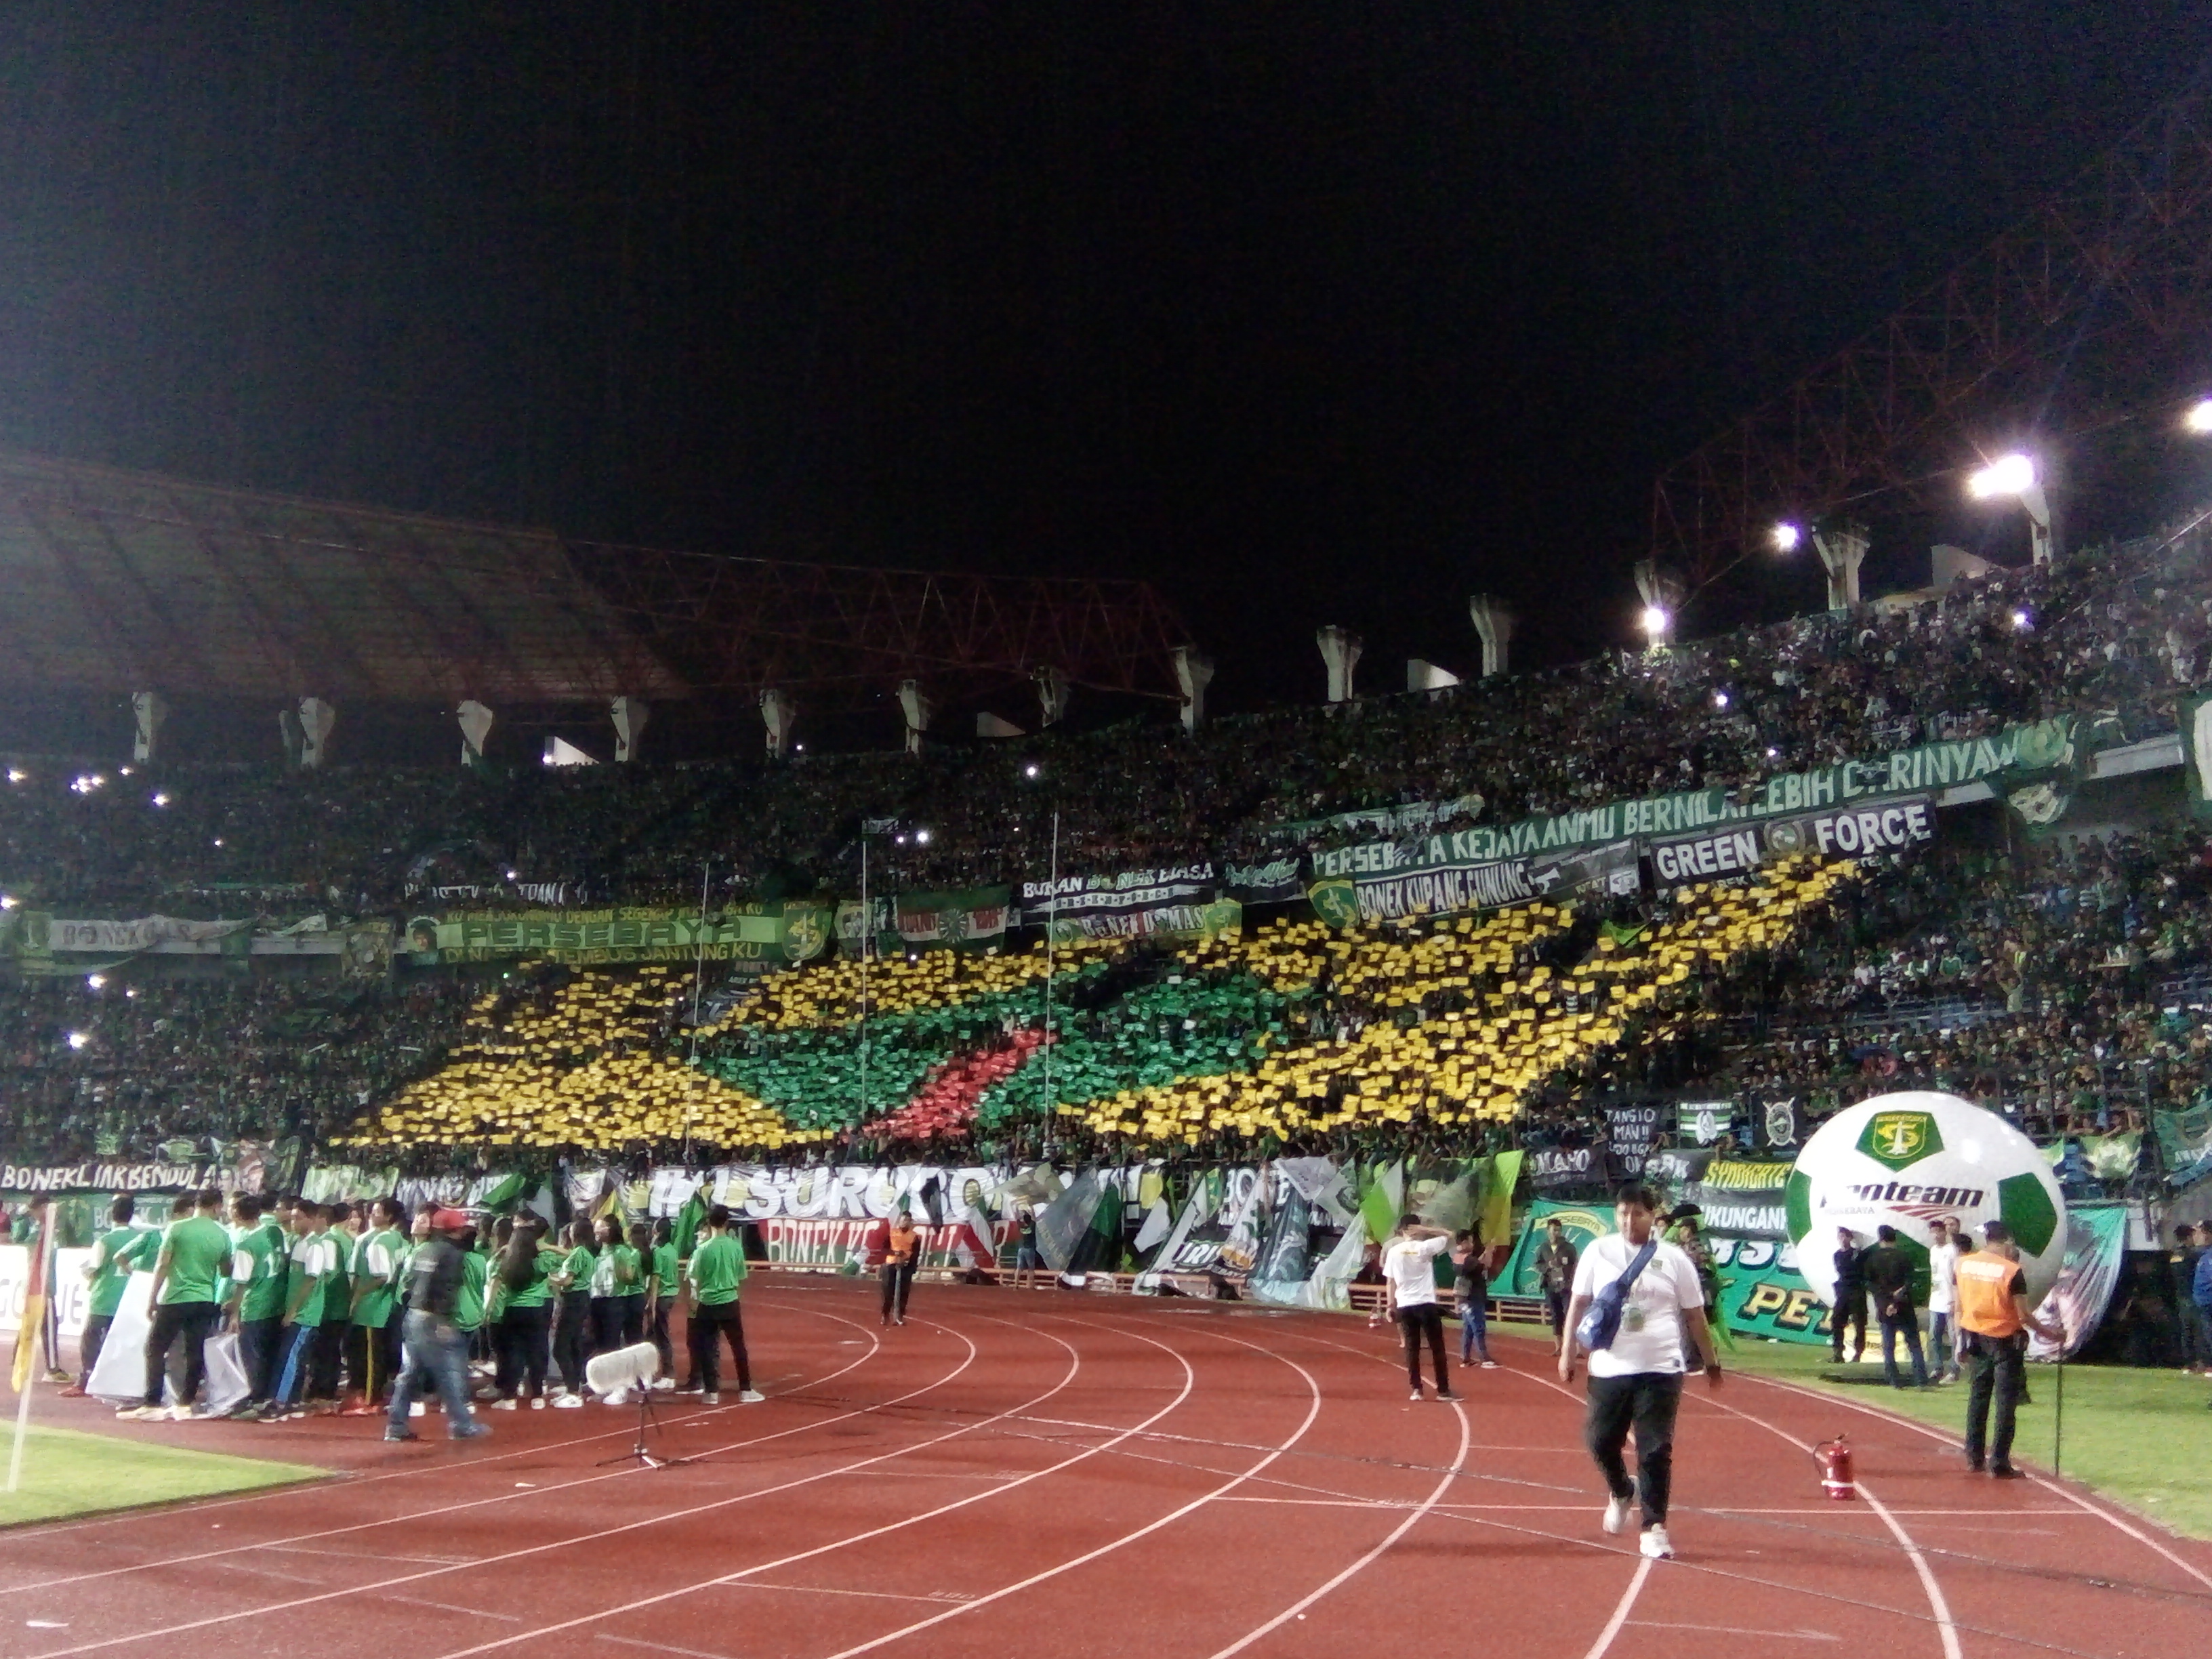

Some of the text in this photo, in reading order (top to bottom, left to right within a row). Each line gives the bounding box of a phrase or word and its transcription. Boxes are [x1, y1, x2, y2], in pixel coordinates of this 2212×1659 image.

[1657, 804, 1931, 880] GREEN FORCE
[1357, 882, 1406, 920] BONEK
[463, 917, 741, 948] PERSEBAYA
[733, 943, 761, 958] KU
